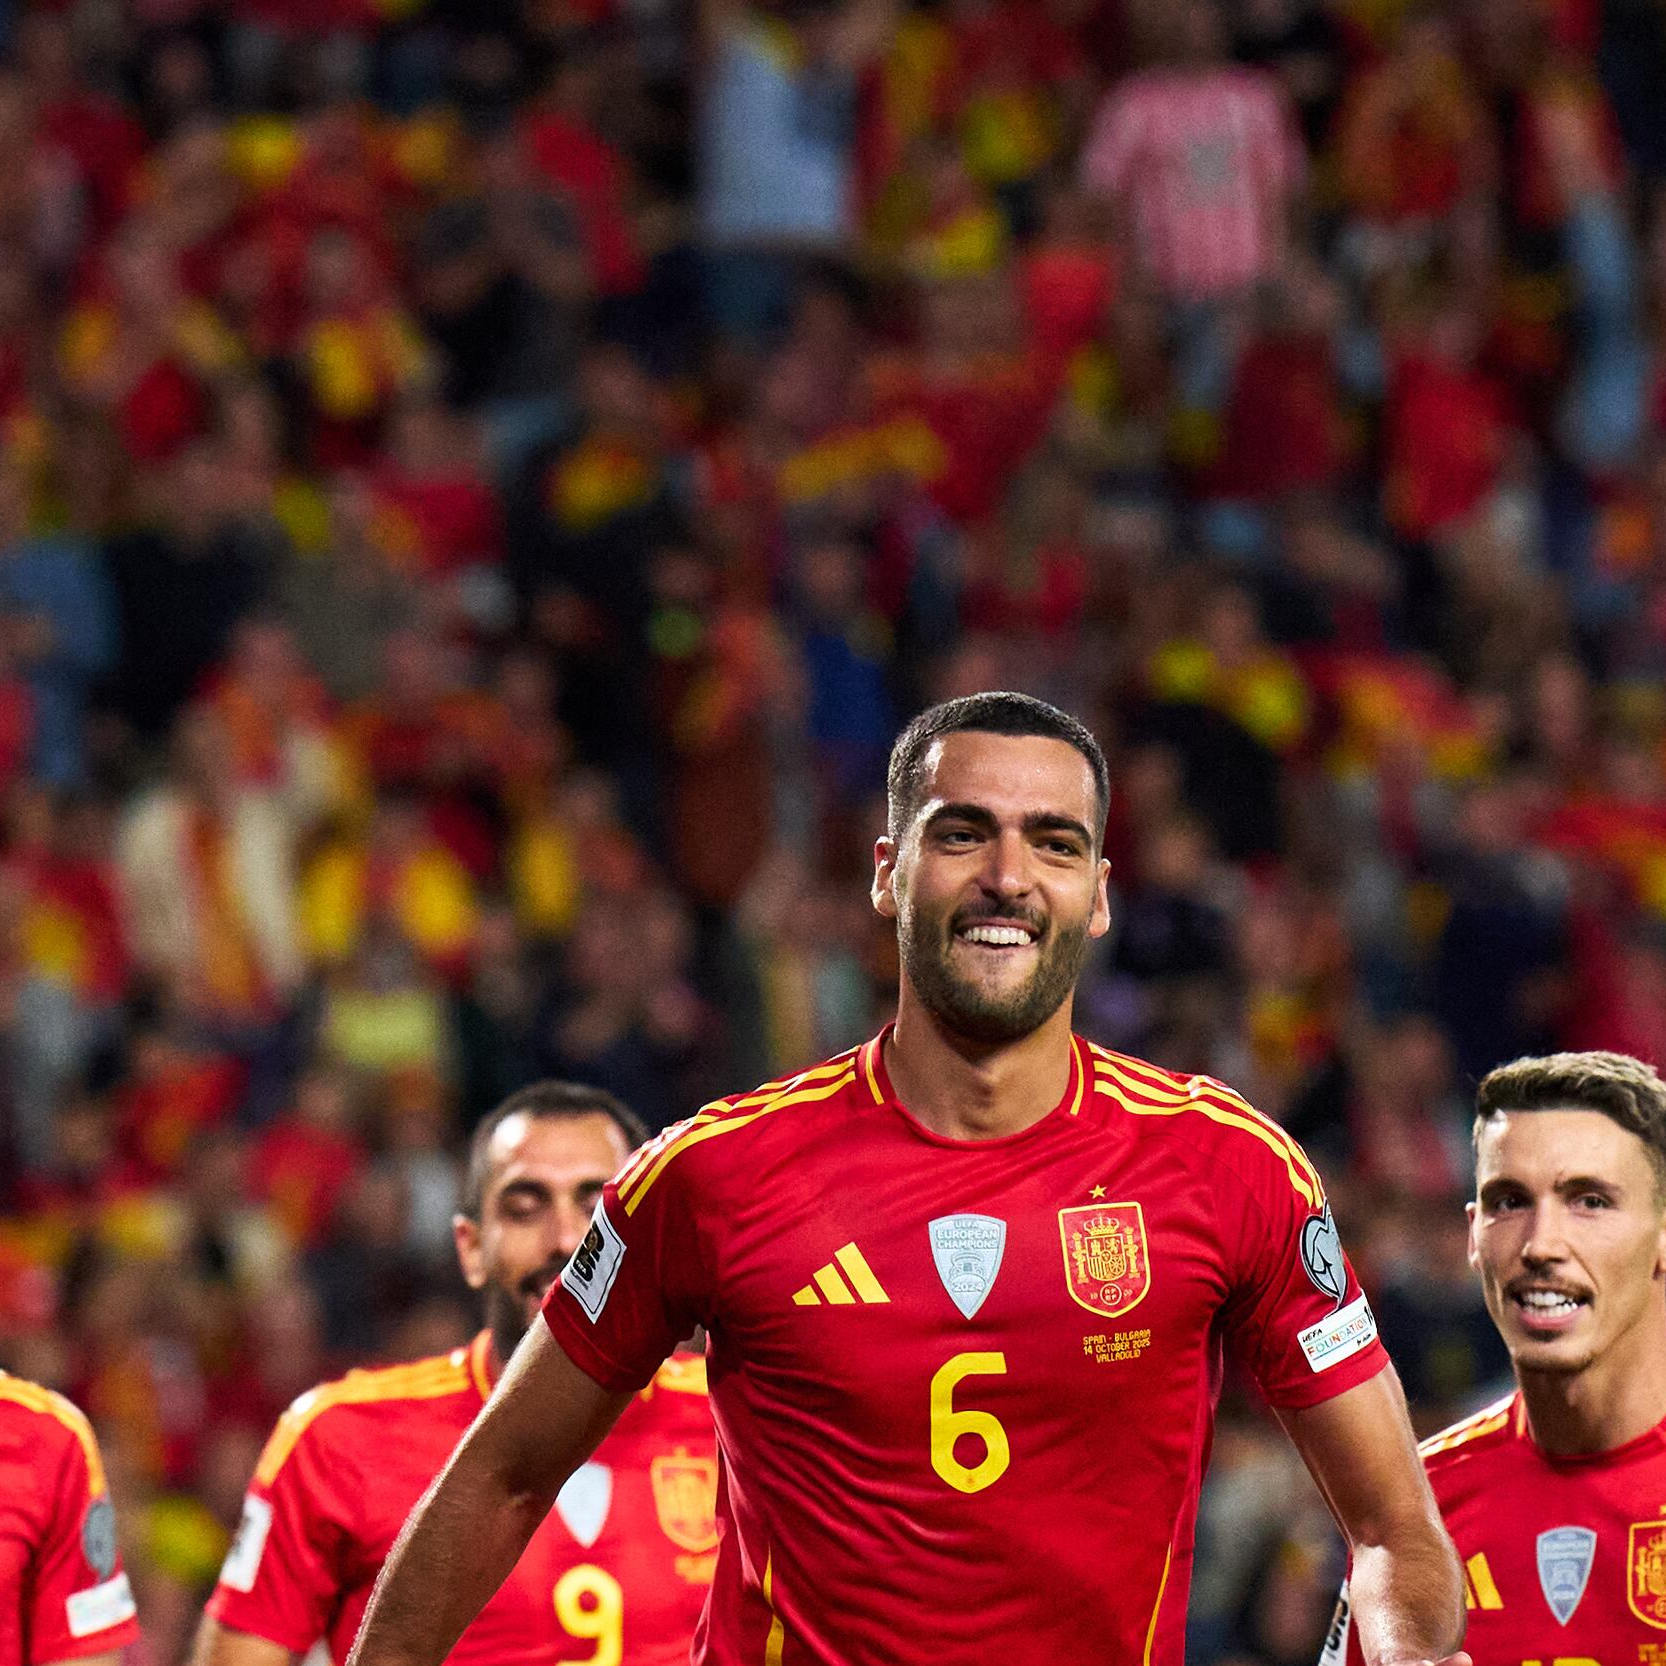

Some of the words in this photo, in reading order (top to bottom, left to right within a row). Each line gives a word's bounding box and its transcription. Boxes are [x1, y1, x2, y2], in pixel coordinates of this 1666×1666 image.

[936, 1229, 998, 1240] EUROPEAN
[936, 1239, 999, 1249] CHAMPIONS
[953, 1281, 983, 1292] 2024
[1083, 1334, 1106, 1346] SPAIN
[1114, 1328, 1151, 1342] BULGARIA
[1302, 1328, 1323, 1343] UEFA
[1083, 1345, 1093, 1355] 14
[1095, 1341, 1130, 1353] OCTOBER
[1132, 1337, 1151, 1349] 2025
[930, 1352, 1011, 1493] 6
